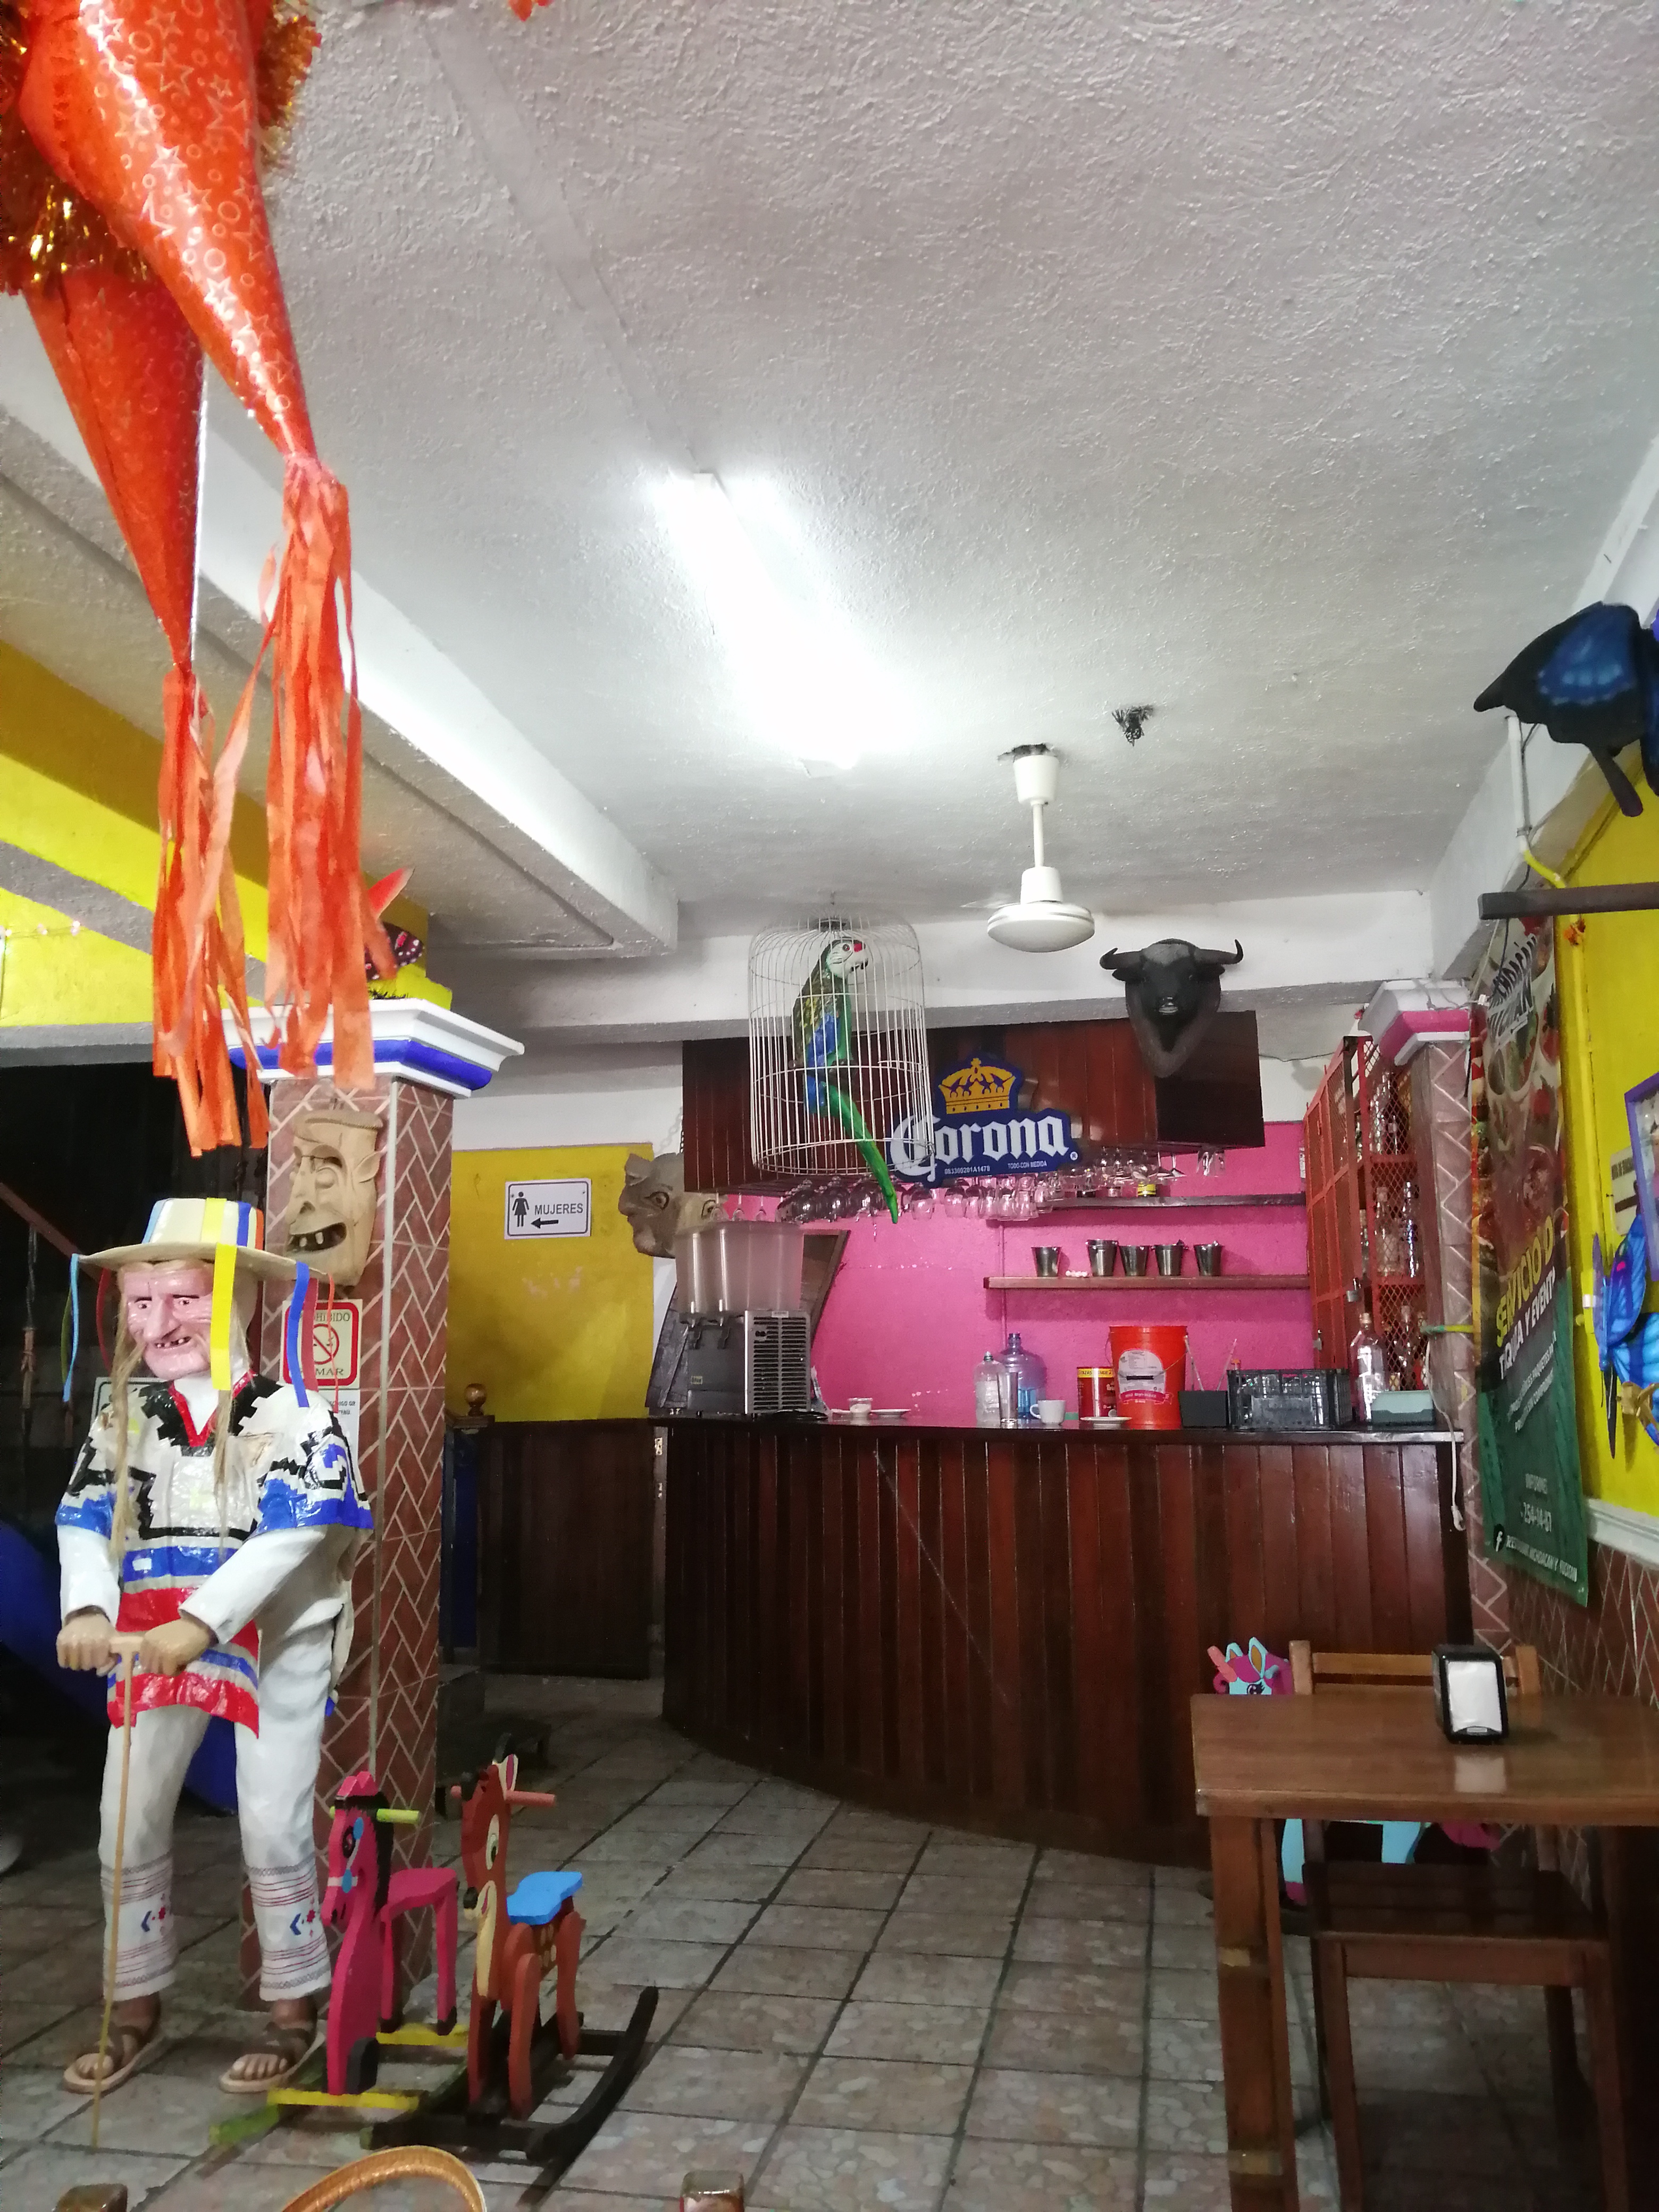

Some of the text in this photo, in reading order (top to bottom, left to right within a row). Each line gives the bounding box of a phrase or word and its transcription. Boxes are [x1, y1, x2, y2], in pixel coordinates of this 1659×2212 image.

[890, 1115, 1069, 1182] Corona
[1030, 1160, 1048, 1168] MEDIDA
[534, 1203, 583, 1216] MUJERES
[1525, 1306, 1531, 1336] Y
